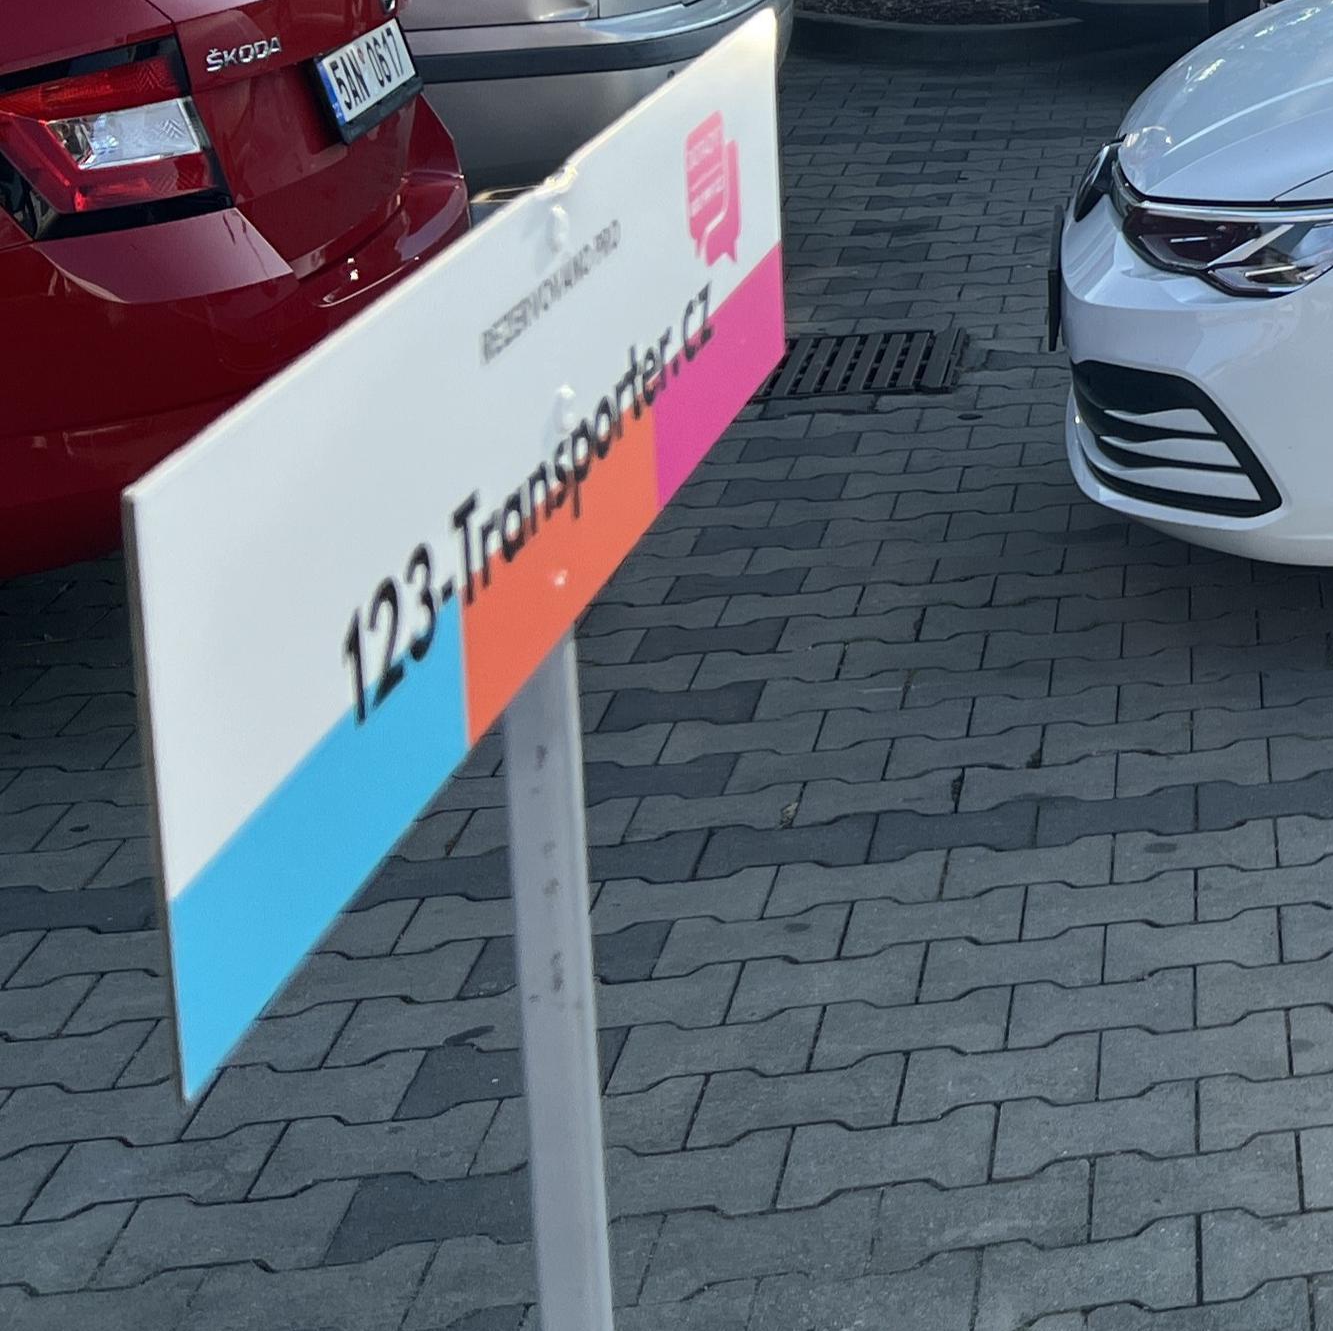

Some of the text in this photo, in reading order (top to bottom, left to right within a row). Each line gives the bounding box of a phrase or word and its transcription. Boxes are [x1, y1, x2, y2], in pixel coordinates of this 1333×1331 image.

[206, 36, 282, 72] ŠKODA
[330, 26, 405, 111] 5AN 0617
[342, 281, 716, 727] 123-Transporter.cz
